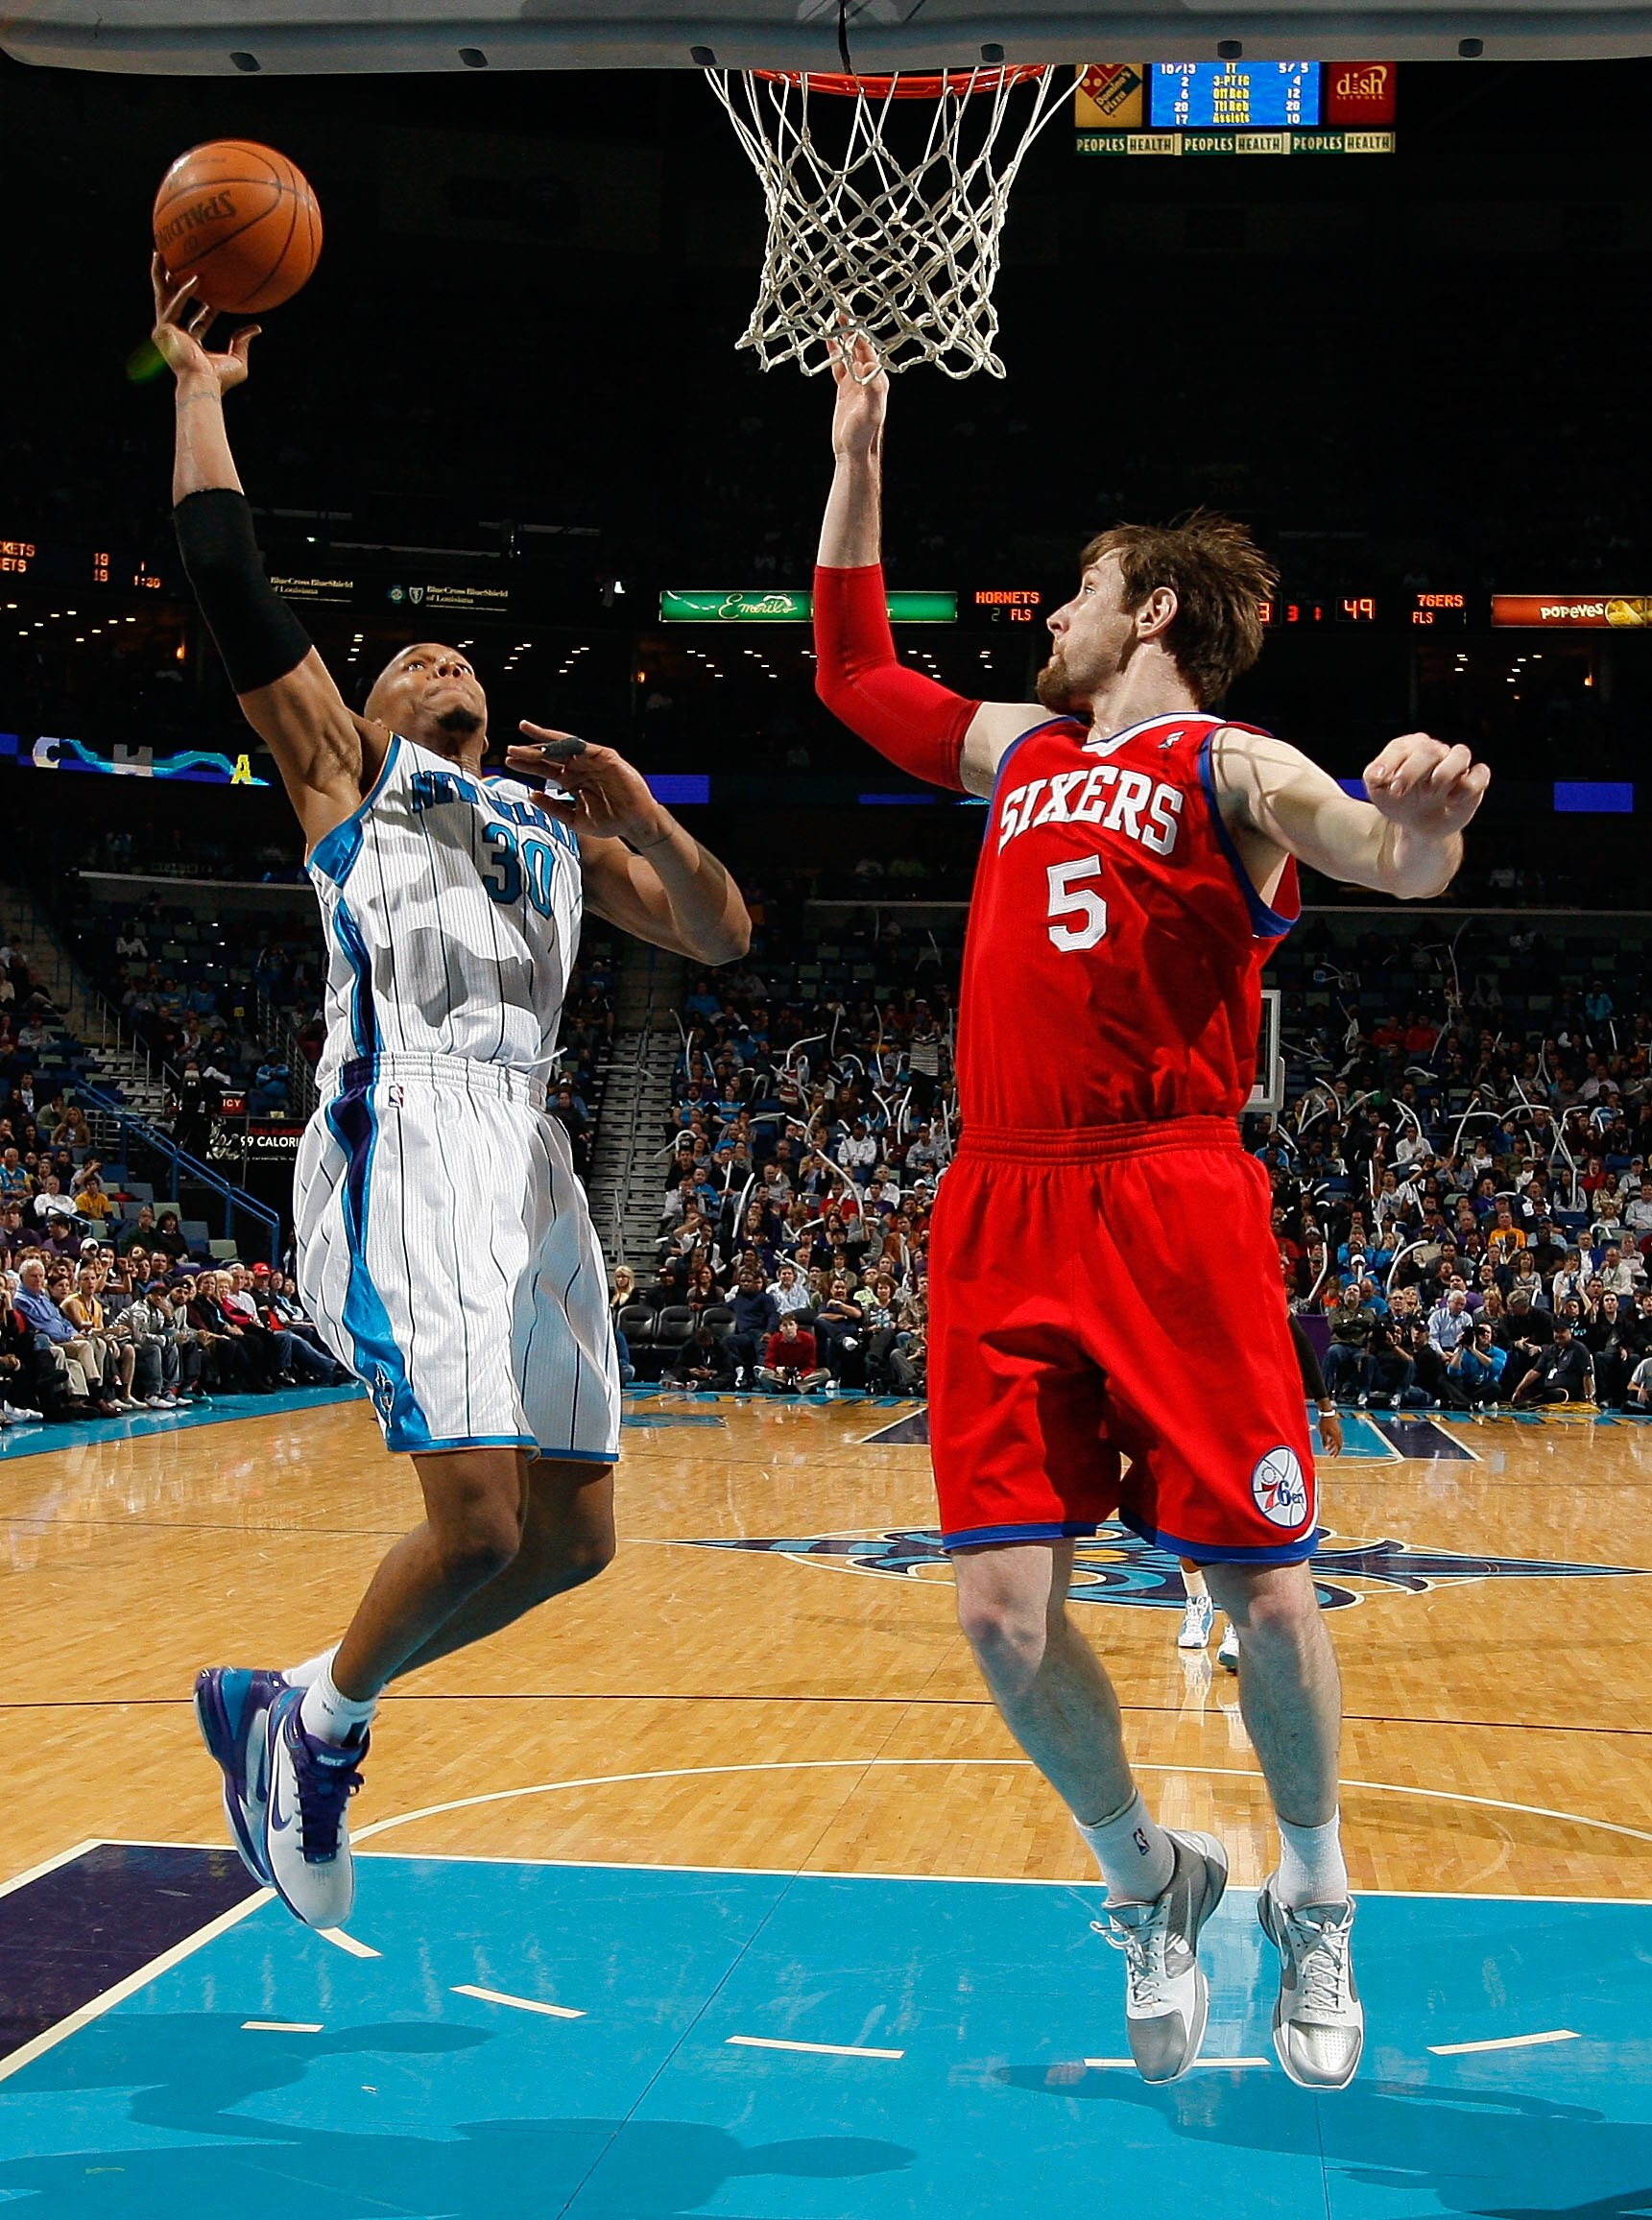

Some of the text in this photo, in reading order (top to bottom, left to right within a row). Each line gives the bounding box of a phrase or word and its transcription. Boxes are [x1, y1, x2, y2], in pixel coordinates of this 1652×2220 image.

[1161, 63, 1197, 74] 10/13
[1181, 76, 1189, 87] 2
[1292, 76, 1302, 86] 4
[1336, 71, 1385, 95] dish
[1181, 89, 1189, 100] 6
[1287, 88, 1302, 99] 12
[1174, 101, 1189, 112] 28
[1285, 101, 1302, 111] 28
[1175, 114, 1189, 125] 17
[1212, 111, 1251, 124] Assists
[1286, 113, 1301, 124] 10
[1076, 137, 1172, 152] PEOPLES HEALTH
[1185, 136, 1282, 152] PEOPLES HEALTH
[1293, 135, 1391, 151] PEOPLES HEALTH
[0, 558, 27, 573] ETS
[94, 553, 108, 566] 19
[93, 569, 108, 583] 19
[133, 575, 160, 588] 1:30
[975, 591, 1040, 604] HORNETS
[1417, 594, 1464, 608] 76ERS
[1011, 609, 1032, 621] FLS
[1344, 599, 1373, 620] 49
[1412, 611, 1433, 624] FLS
[411, 771, 479, 813] NEW
[997, 765, 1185, 857] SIXERS
[481, 822, 556, 920] 30
[1046, 854, 1108, 953] 5
[222, 1098, 242, 1108] ICY
